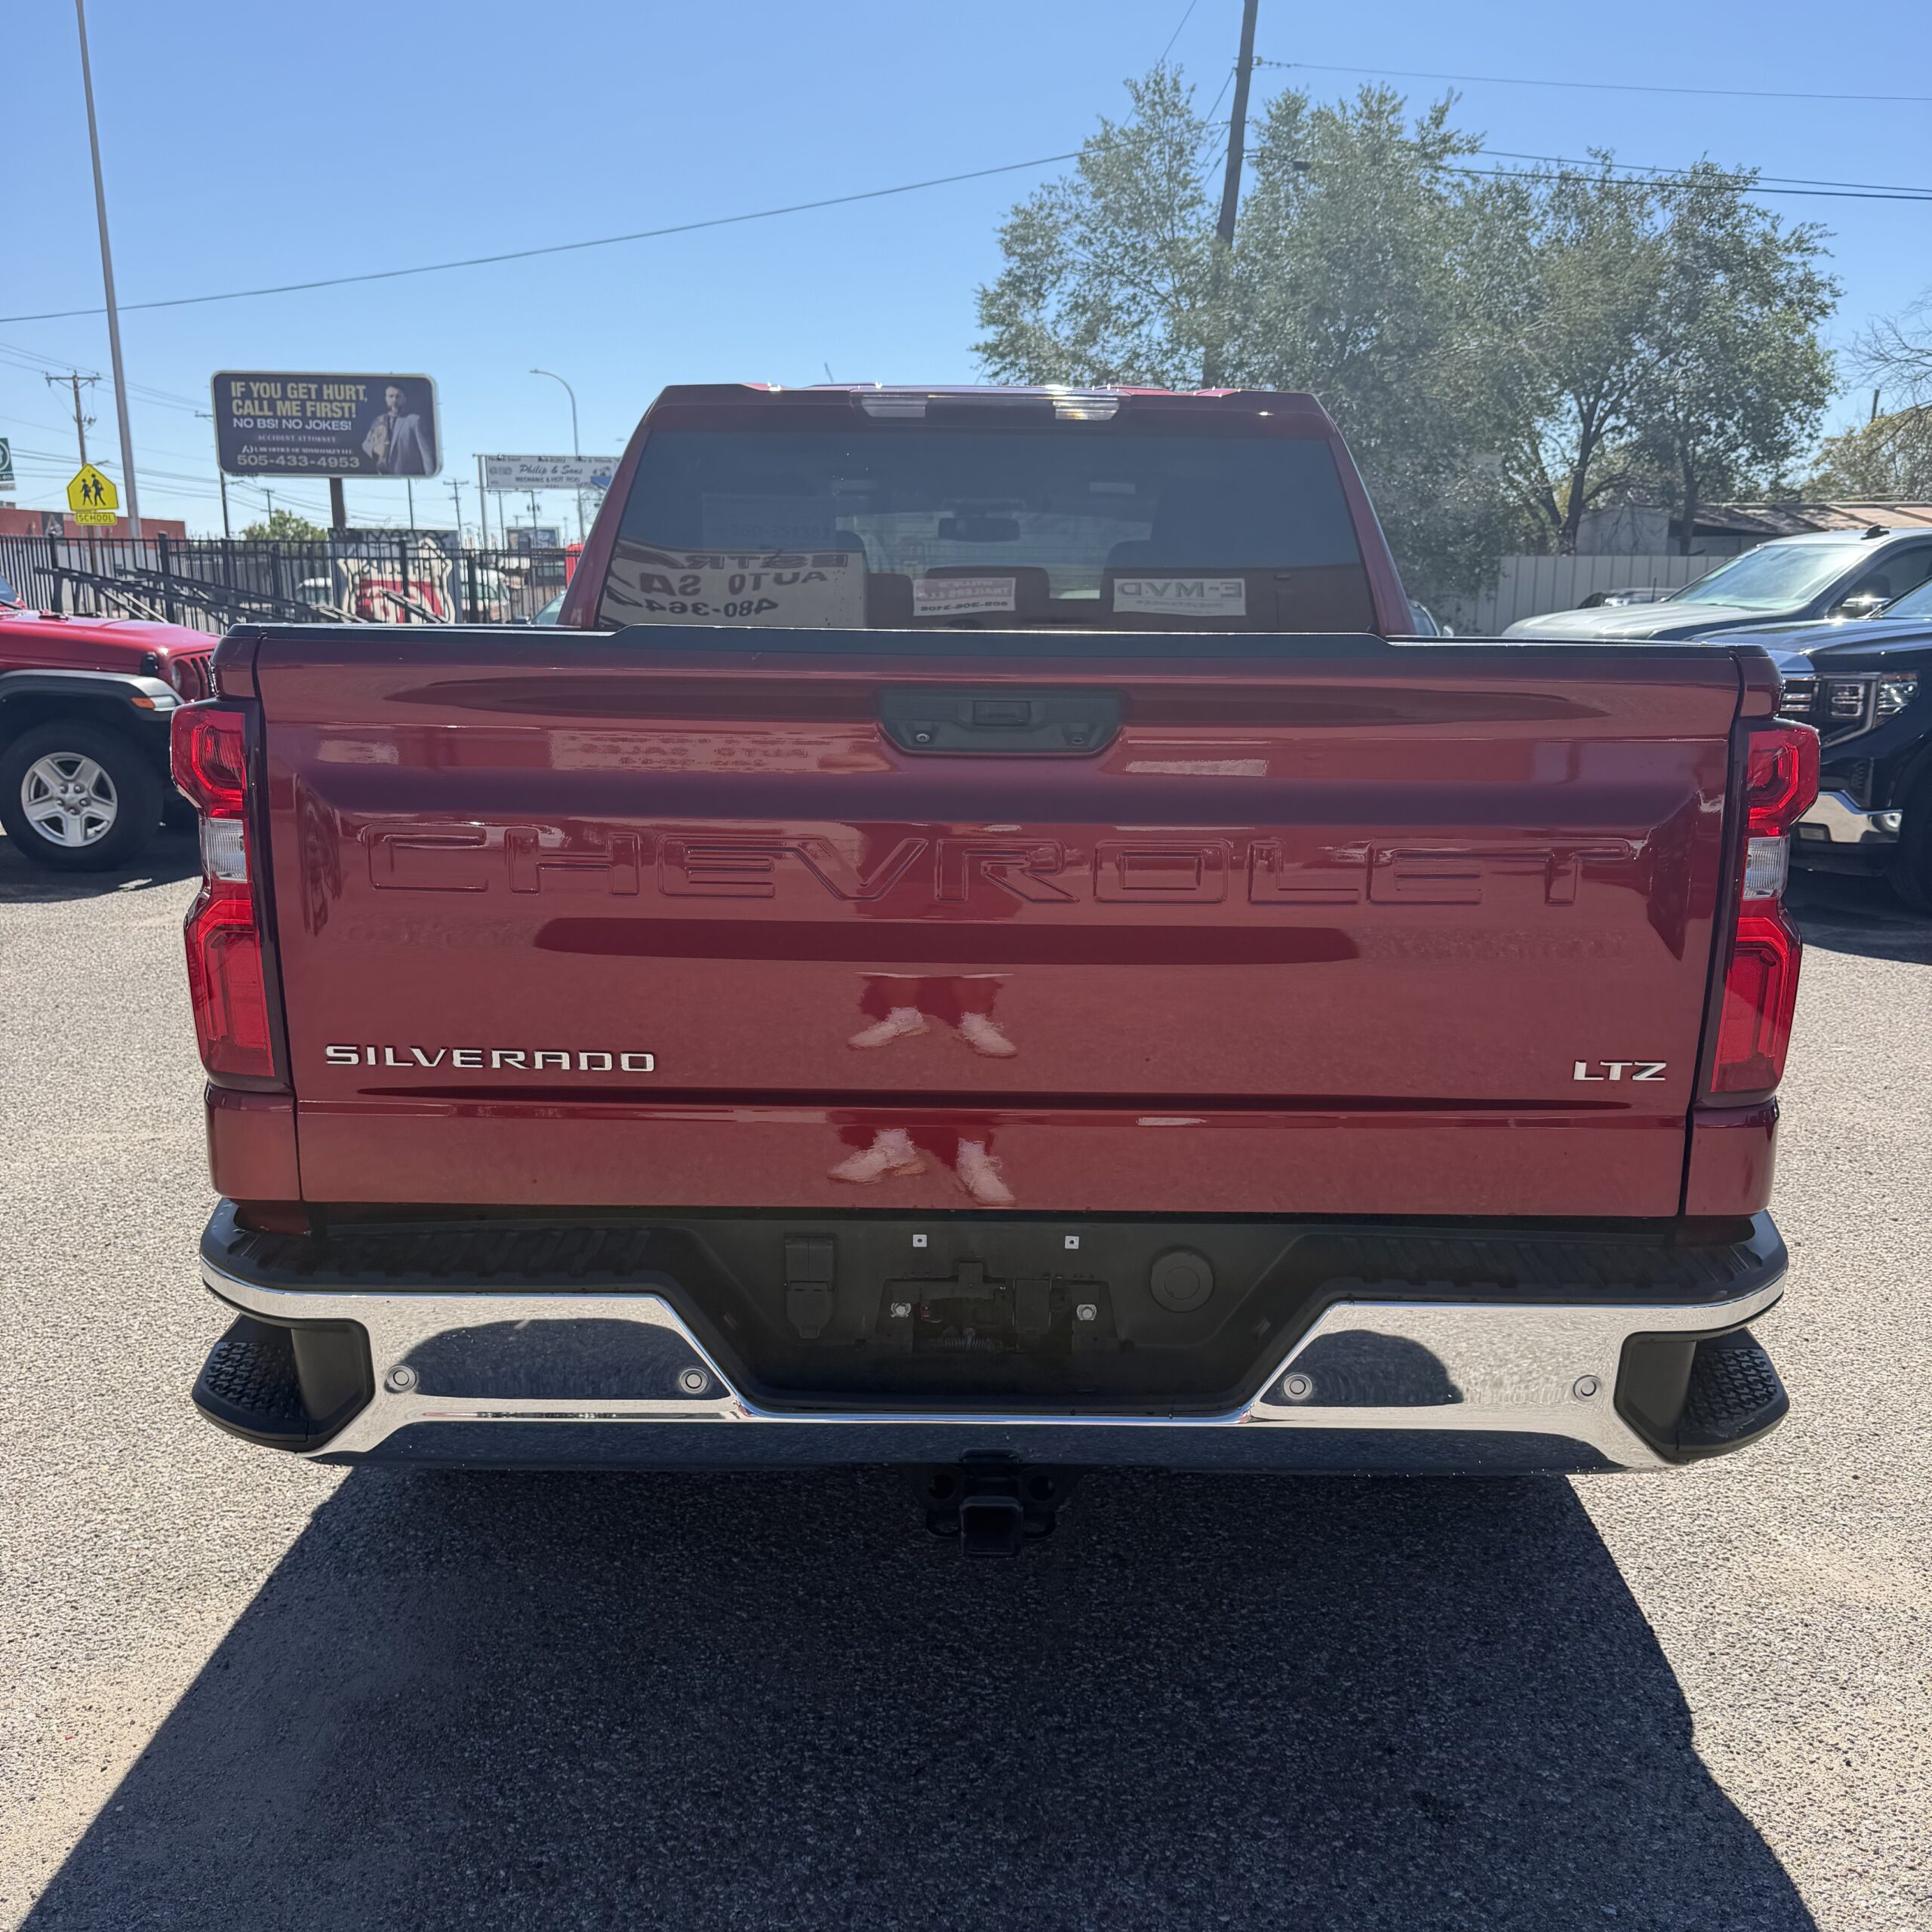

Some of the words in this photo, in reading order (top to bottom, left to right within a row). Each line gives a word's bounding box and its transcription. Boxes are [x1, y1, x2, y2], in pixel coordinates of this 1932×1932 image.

[230, 381, 246, 398] IF
[251, 382, 281, 399] YOU
[287, 383, 318, 400] GET
[323, 383, 368, 402] HURT,
[232, 399, 273, 417] CALL
[276, 401, 301, 417] ME
[306, 401, 356, 418] FIRST!
[233, 418, 254, 429] NO
[257, 418, 278, 429] BS!
[282, 419, 302, 430] NO
[305, 420, 352, 431] JOKES!
[237, 454, 360, 468] 505-433-4953
[518, 464, 547, 475] Philip
[561, 465, 583, 475] Sons
[78, 514, 113, 523] SCHOOL
[362, 822, 1632, 905] CHEVROLET
[325, 1044, 656, 1072] SILVERADO
[1573, 1060, 1667, 1081] LTZ
